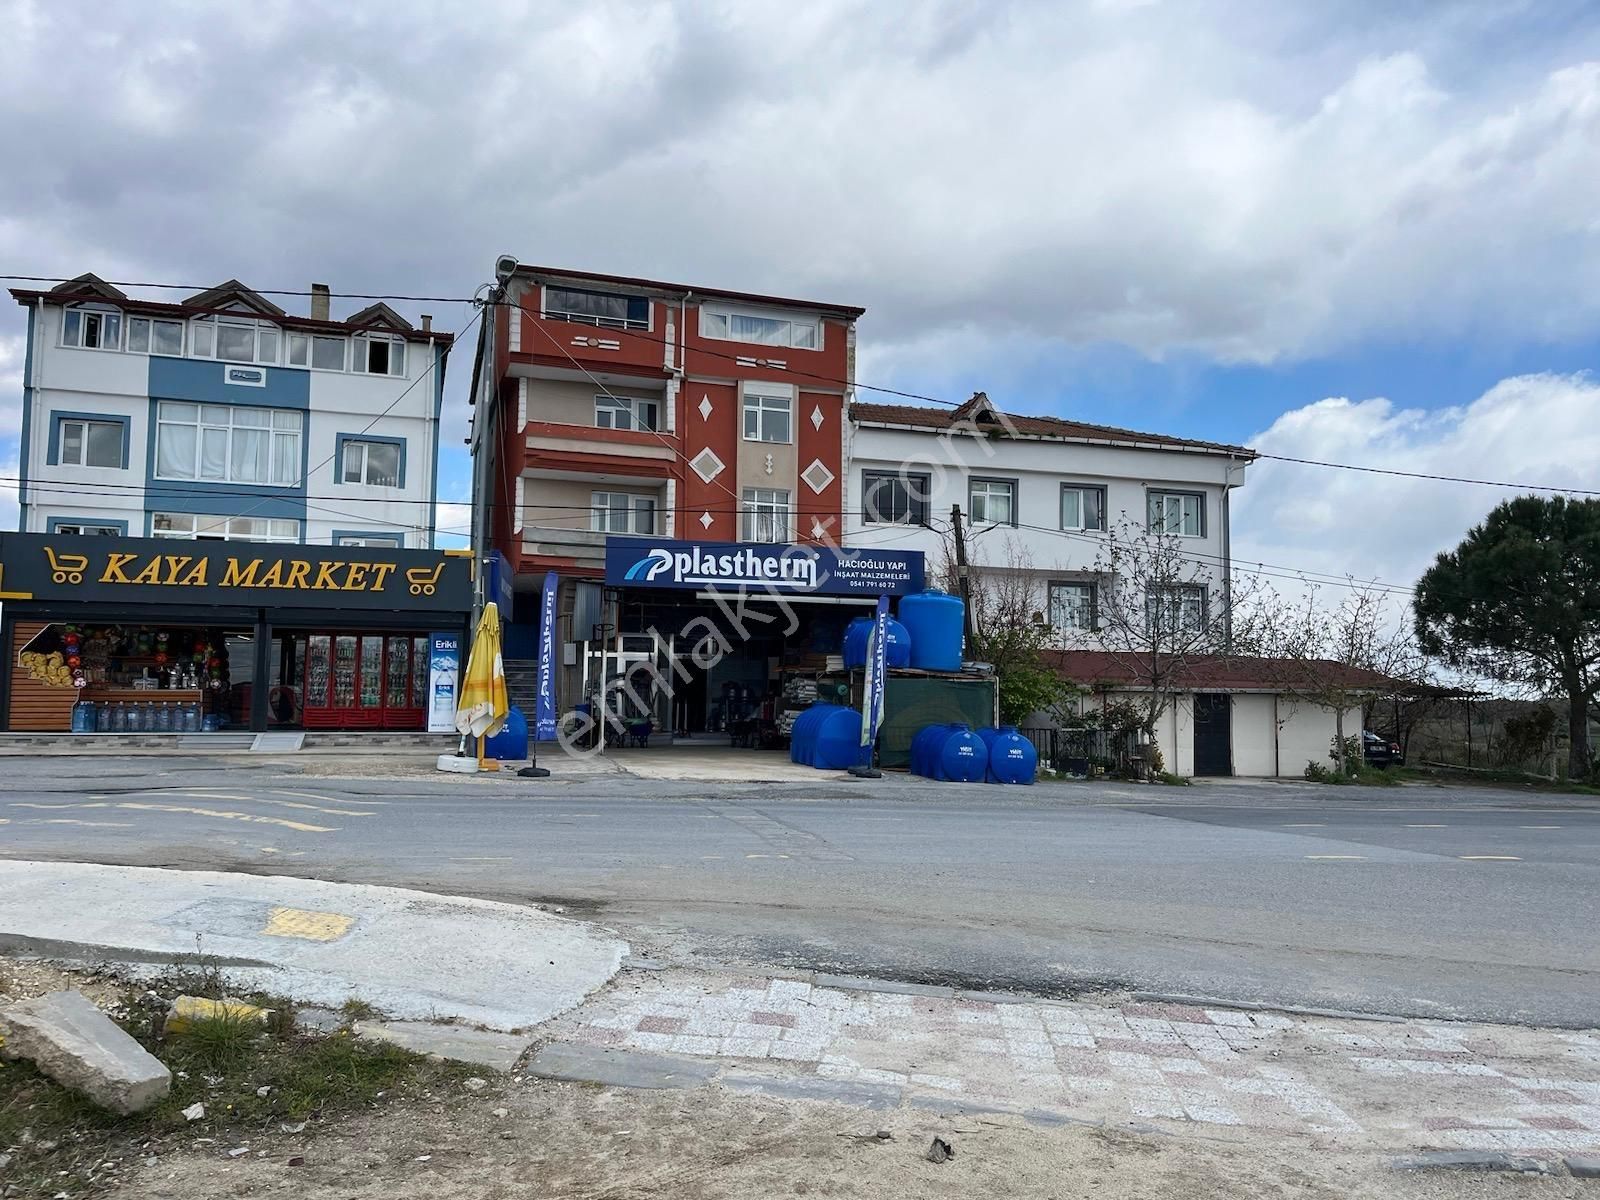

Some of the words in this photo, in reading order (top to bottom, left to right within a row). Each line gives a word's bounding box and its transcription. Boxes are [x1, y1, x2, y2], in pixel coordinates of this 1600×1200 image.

[838, 559, 884, 569] HACIOĞLU
[887, 561, 906, 570] YAPI
[98, 553, 209, 586] KAYA
[218, 557, 396, 591] MARKET
[834, 570, 859, 579] İNŞAAT
[860, 571, 911, 580] MALZEMELERİ
[435, 640, 457, 649] Erikli
